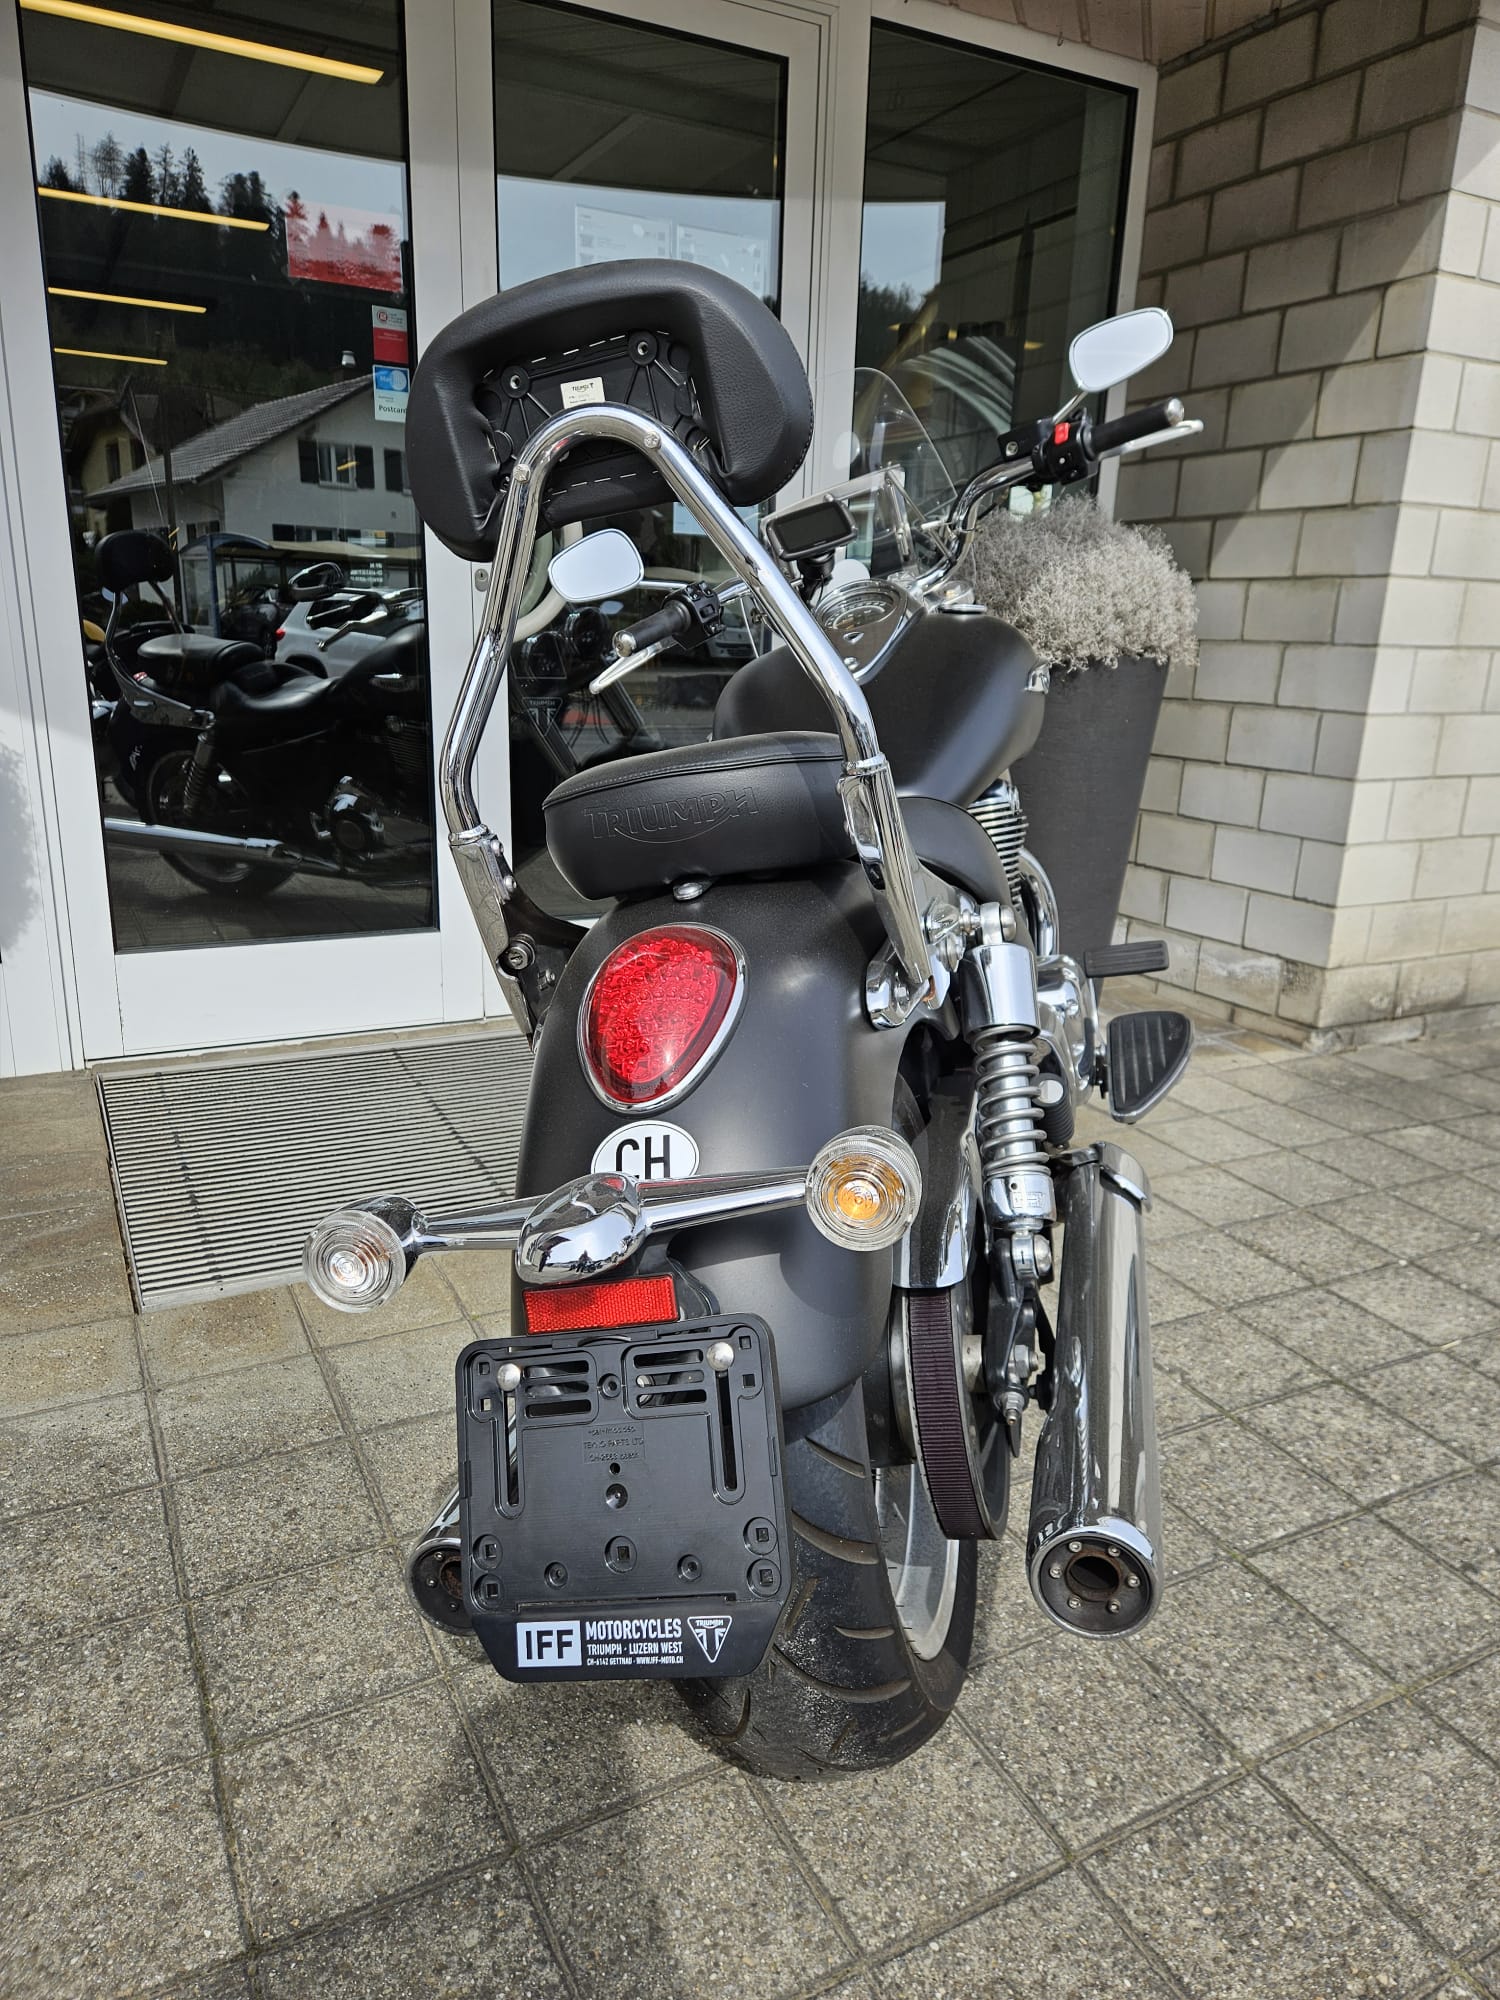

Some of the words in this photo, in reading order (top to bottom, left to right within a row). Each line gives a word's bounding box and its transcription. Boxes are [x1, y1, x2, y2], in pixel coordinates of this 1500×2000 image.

[584, 787, 759, 838] TRIUMPH
[616, 1135, 671, 1179] CH
[585, 1618, 682, 1640] MOTORCYCLES
[695, 1619, 724, 1627] TRIUMPH
[526, 1629, 573, 1660] IFF
[586, 1643, 622, 1656] TRIUMPH
[628, 1642, 659, 1655] LUZERN
[660, 1641, 683, 1654] WEST
[609, 1657, 632, 1665] GETTNAU
